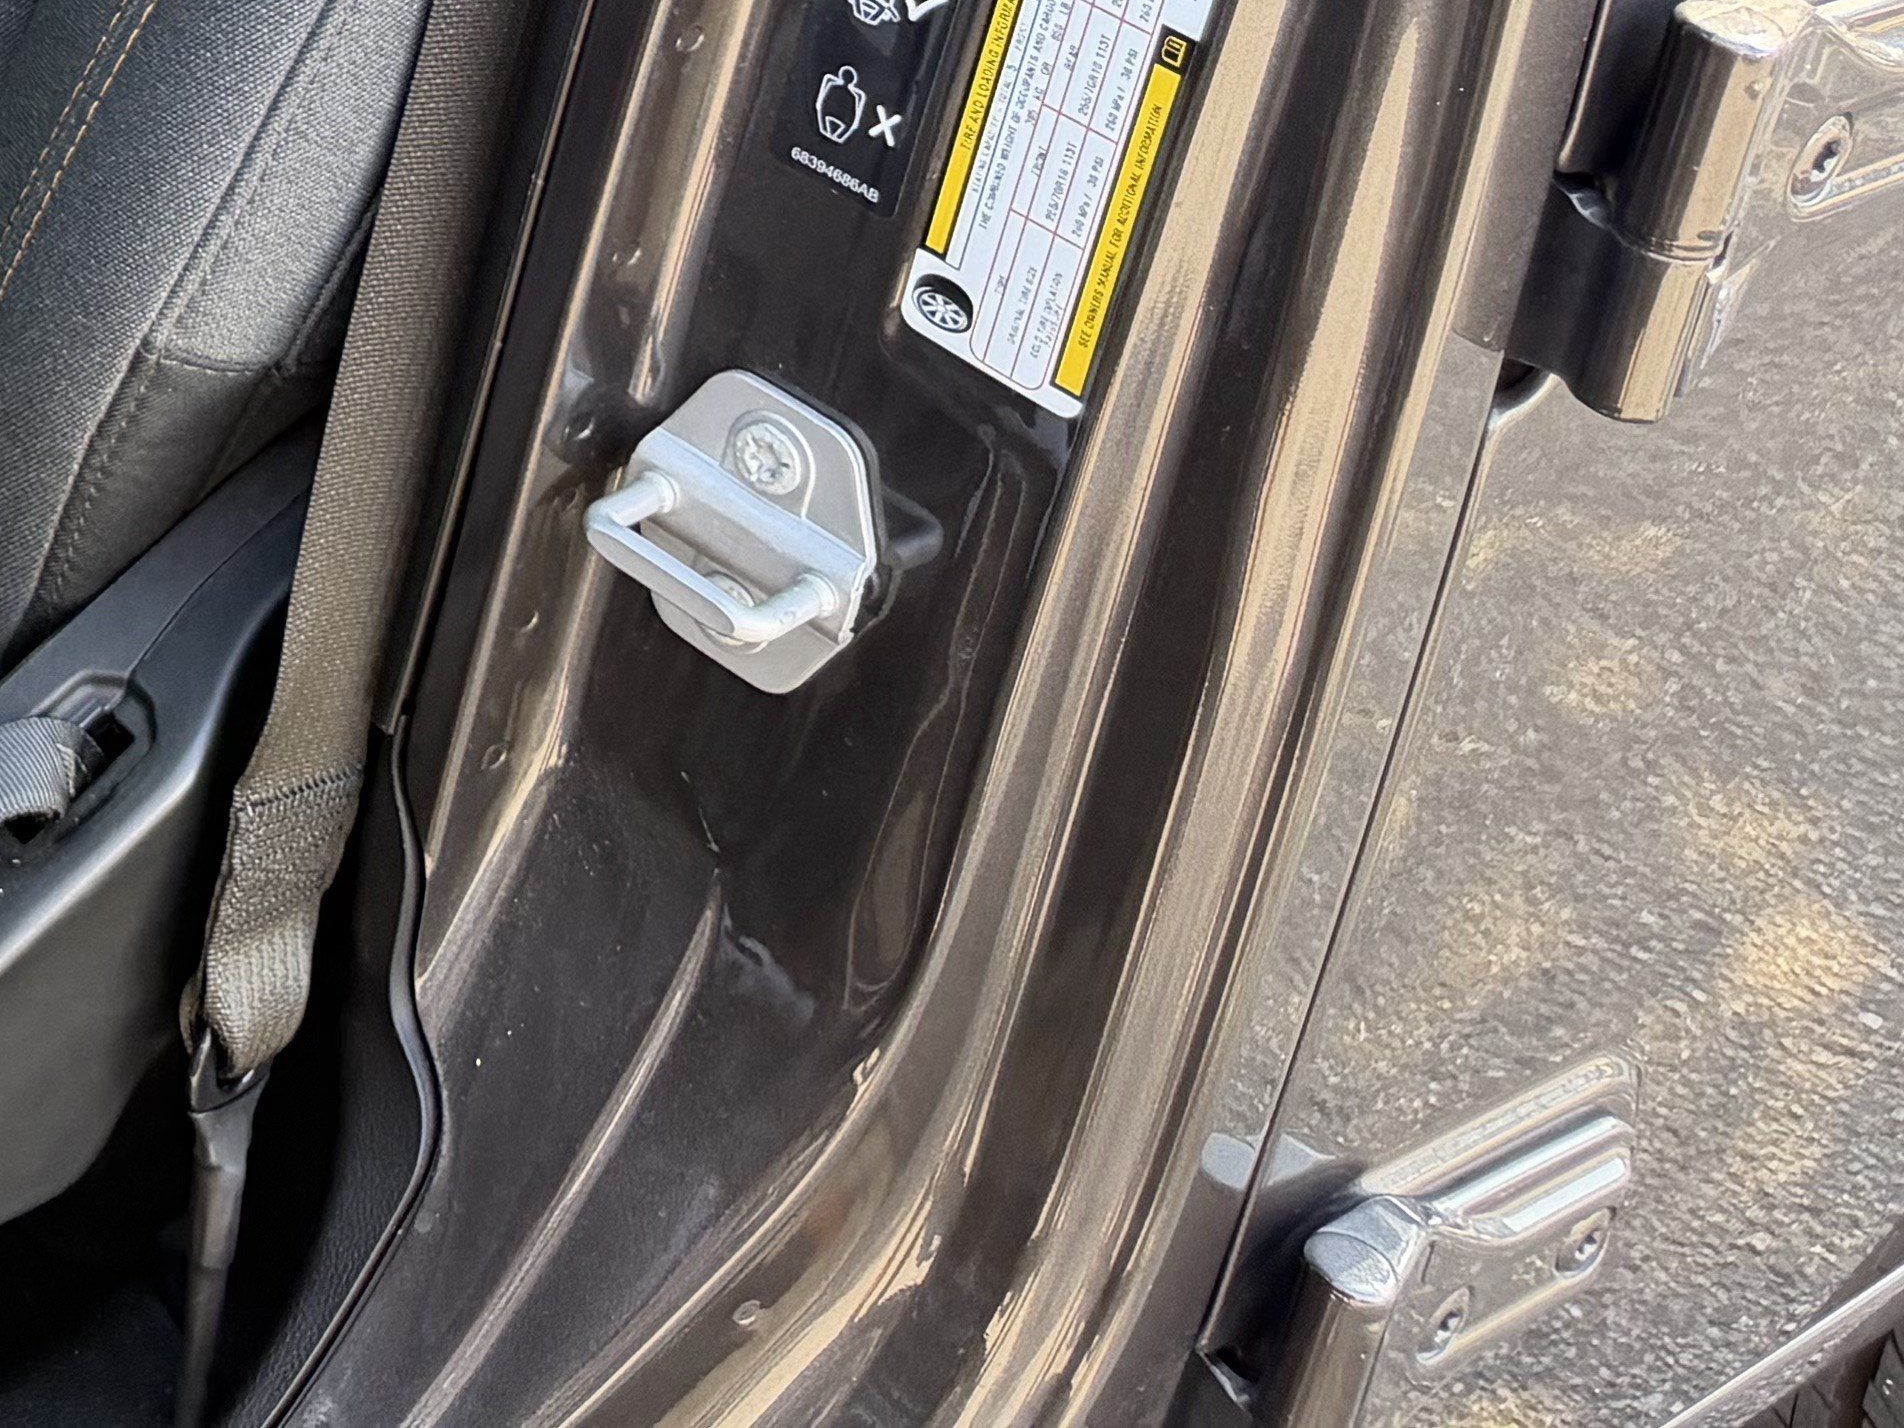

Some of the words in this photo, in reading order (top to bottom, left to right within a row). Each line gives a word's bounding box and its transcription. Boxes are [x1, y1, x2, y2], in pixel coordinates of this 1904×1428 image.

[975, 47, 1000, 98] LOADING
[968, 98, 984, 123] AND
[1077, 329, 1091, 348] SEE
